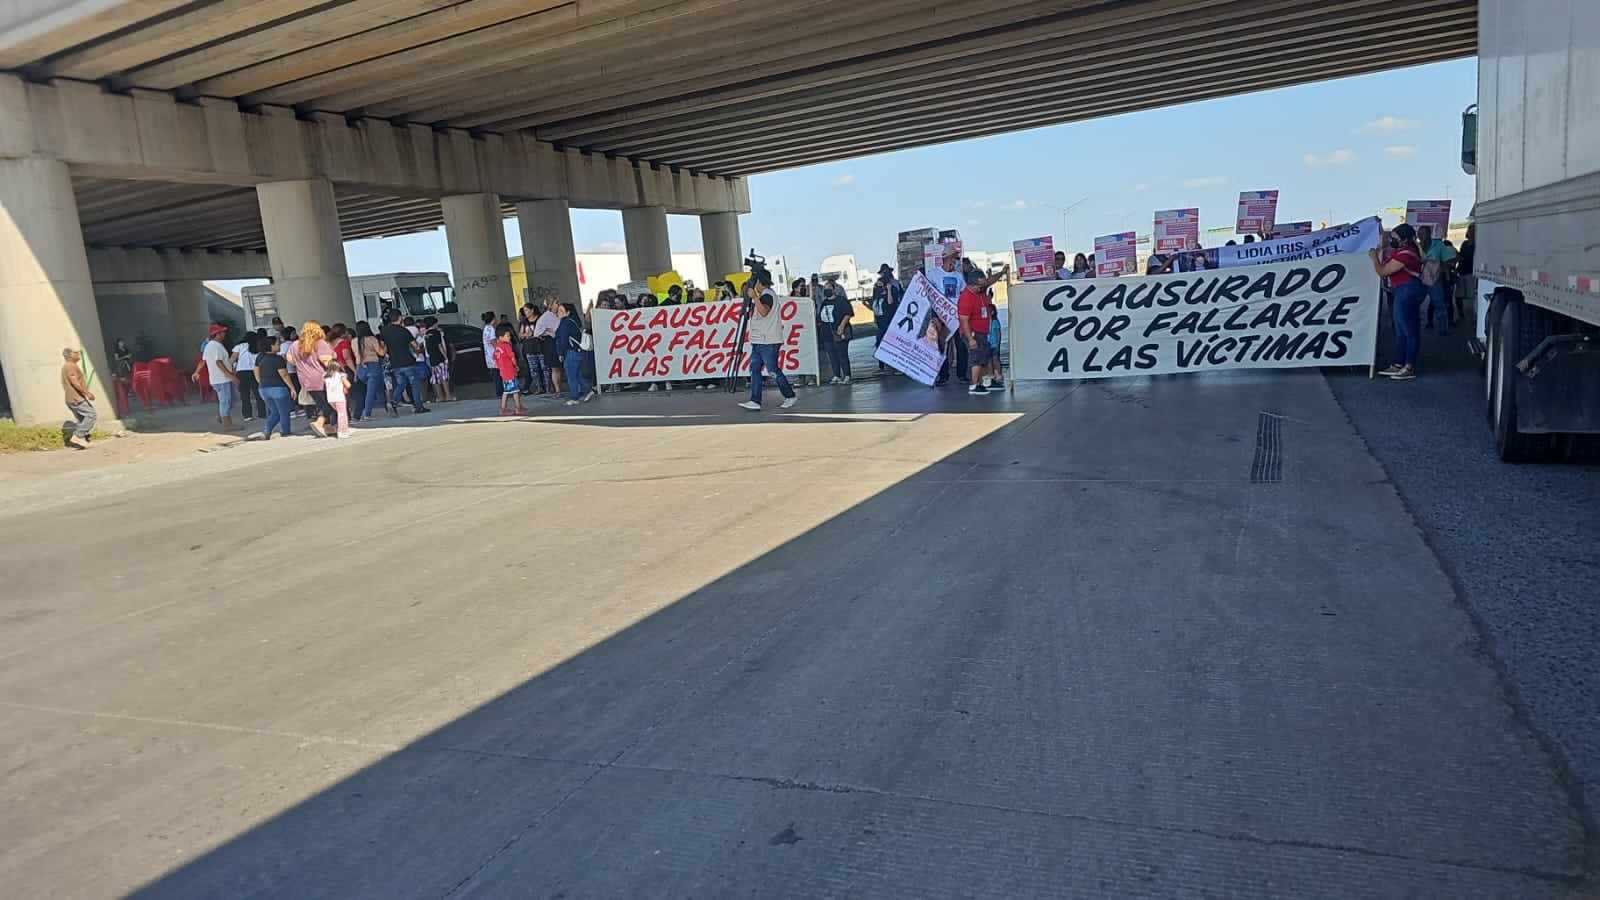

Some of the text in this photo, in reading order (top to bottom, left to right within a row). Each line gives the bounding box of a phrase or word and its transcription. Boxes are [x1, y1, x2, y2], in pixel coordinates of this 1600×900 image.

[1237, 246, 1273, 260] LIDIA
[1316, 244, 1343, 258] DEL
[1042, 263, 1346, 312] CLAUSURADO
[609, 300, 798, 333] CLAUSURO
[1046, 295, 1360, 343] POR FALLARLE
[609, 324, 804, 355] POR FALLE
[1048, 330, 1353, 373] A LAS VÍCTIMAS
[608, 358, 623, 379] A
[628, 354, 674, 378] LAS
